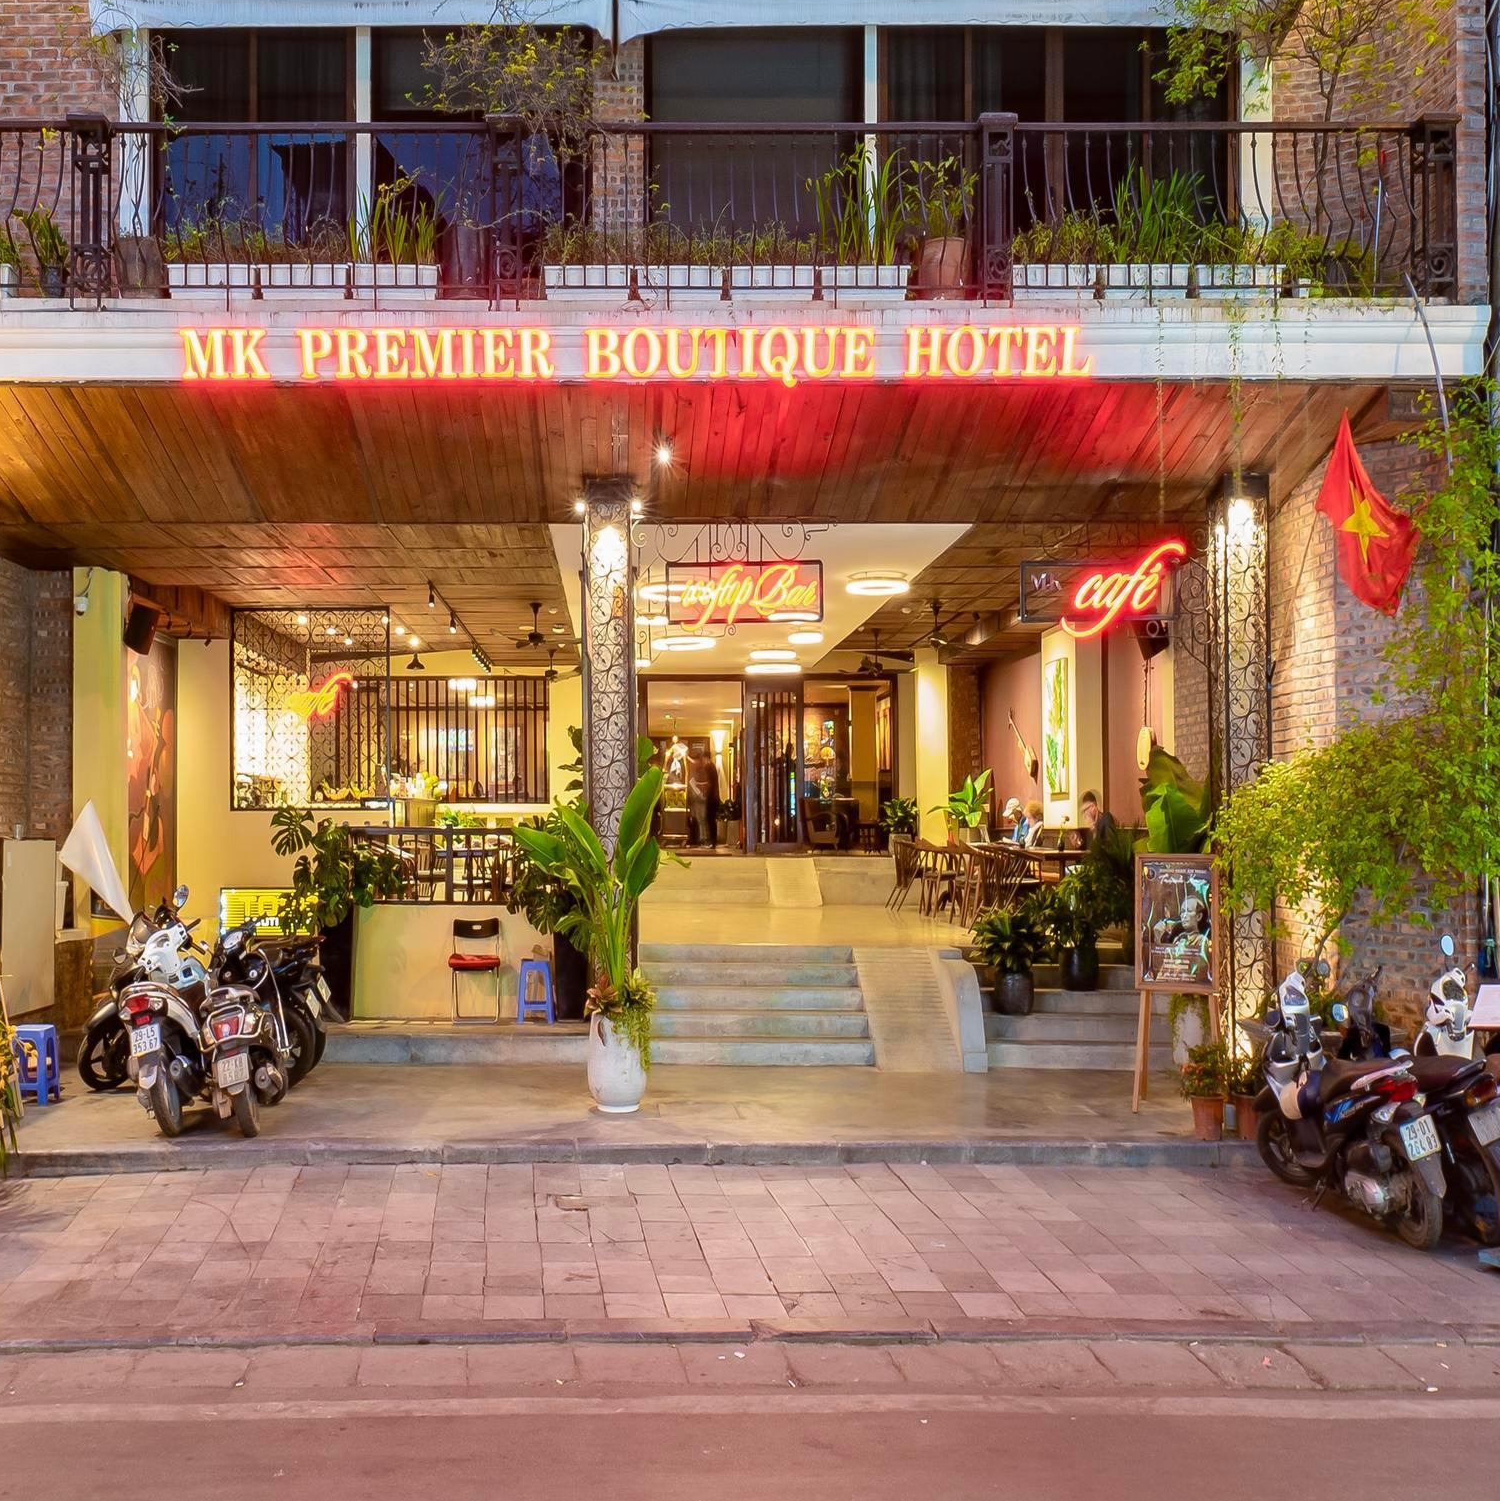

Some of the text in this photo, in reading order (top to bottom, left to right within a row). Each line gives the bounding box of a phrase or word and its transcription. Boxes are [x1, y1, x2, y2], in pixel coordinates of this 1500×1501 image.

[180, 327, 1095, 388] MK PREMIER BOUTIQUE HOTEL
[749, 564, 818, 616] Bar
[1060, 542, 1186, 638] café
